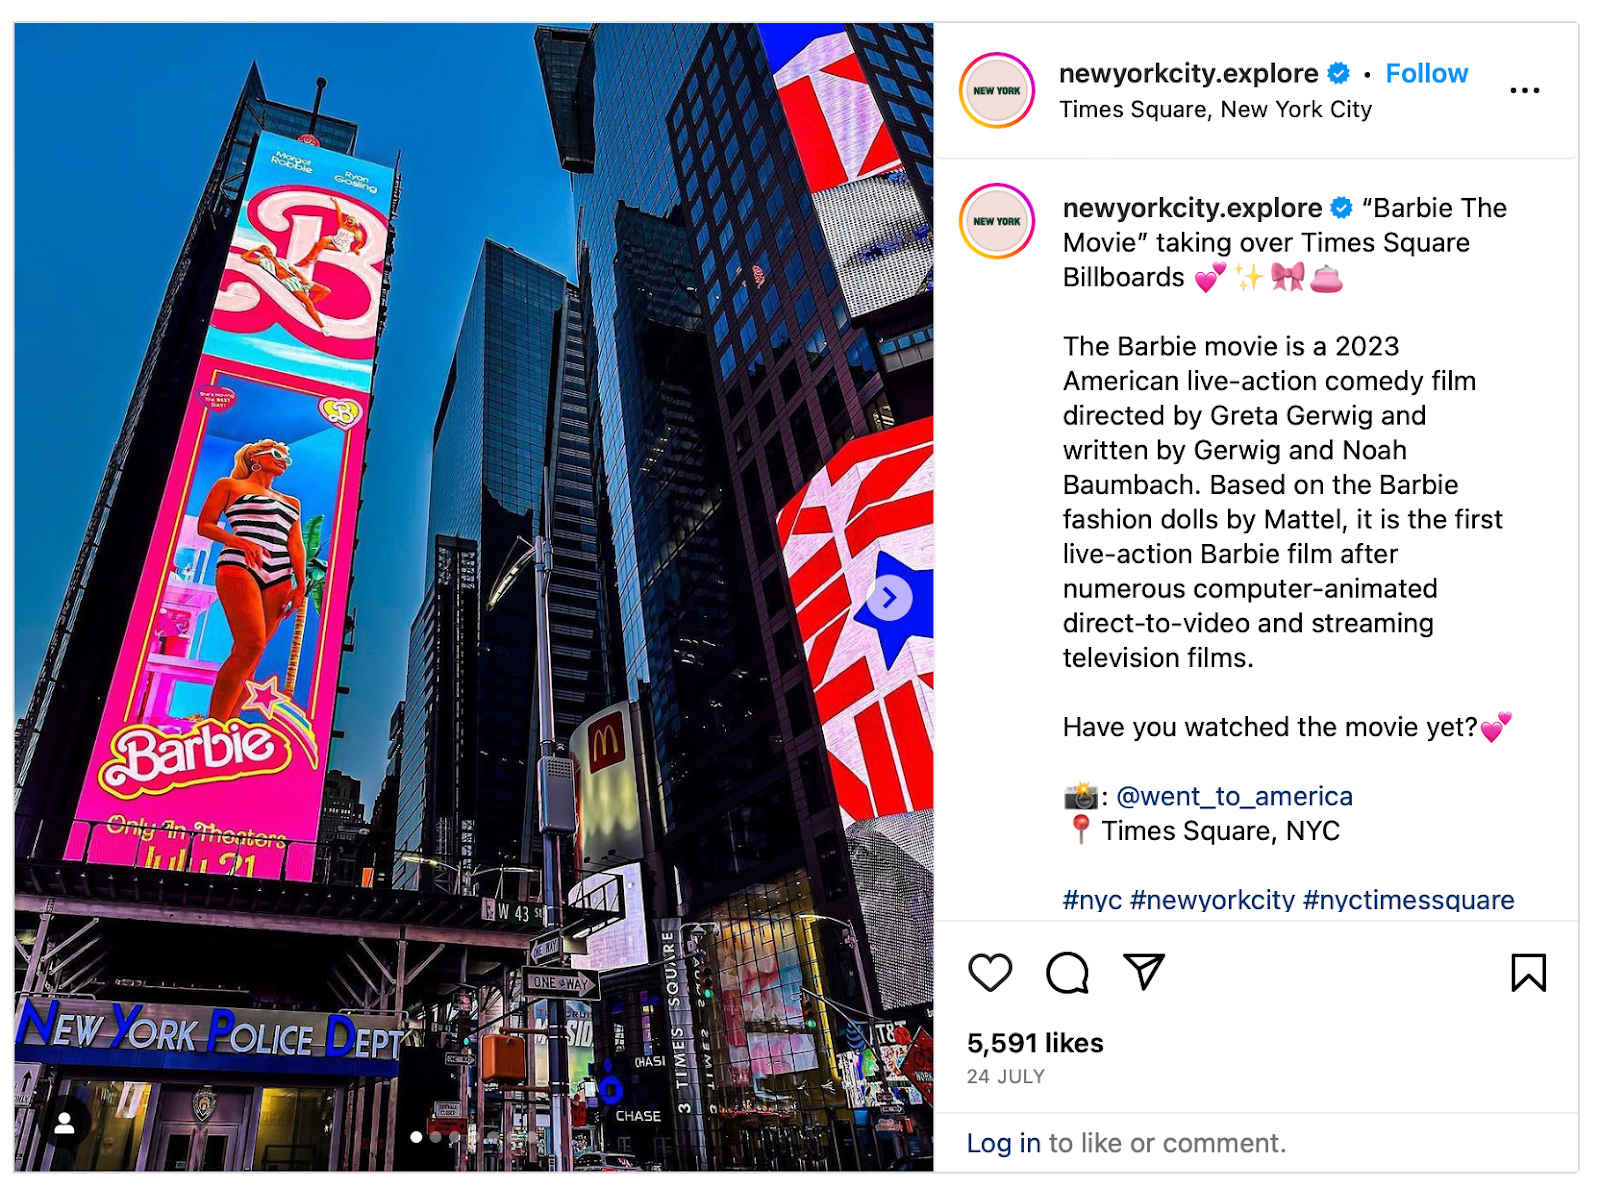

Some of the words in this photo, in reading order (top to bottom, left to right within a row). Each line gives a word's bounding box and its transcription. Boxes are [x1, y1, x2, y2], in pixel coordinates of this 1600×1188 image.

[271, 156, 313, 174] Robbie
[276, 151, 312, 166] Margot
[334, 174, 378, 194] Gosling
[345, 171, 369, 183] Ryan
[104, 724, 275, 787] Barbie
[106, 814, 156, 842] Only
[194, 821, 287, 849] Theaters
[498, 902, 510, 920] W
[515, 905, 529, 922] 43
[661, 931, 681, 1007] SQUARE
[534, 976, 556, 989] ONE
[565, 978, 588, 991] WAY
[15, 1000, 104, 1046] NEW
[111, 1003, 200, 1052] YORK
[207, 1008, 314, 1055] POLICE
[325, 1013, 404, 1061] DEPT
[671, 1027, 689, 1090] TIMES
[616, 1110, 662, 1122] CHASE
[678, 1102, 692, 1114] 3
